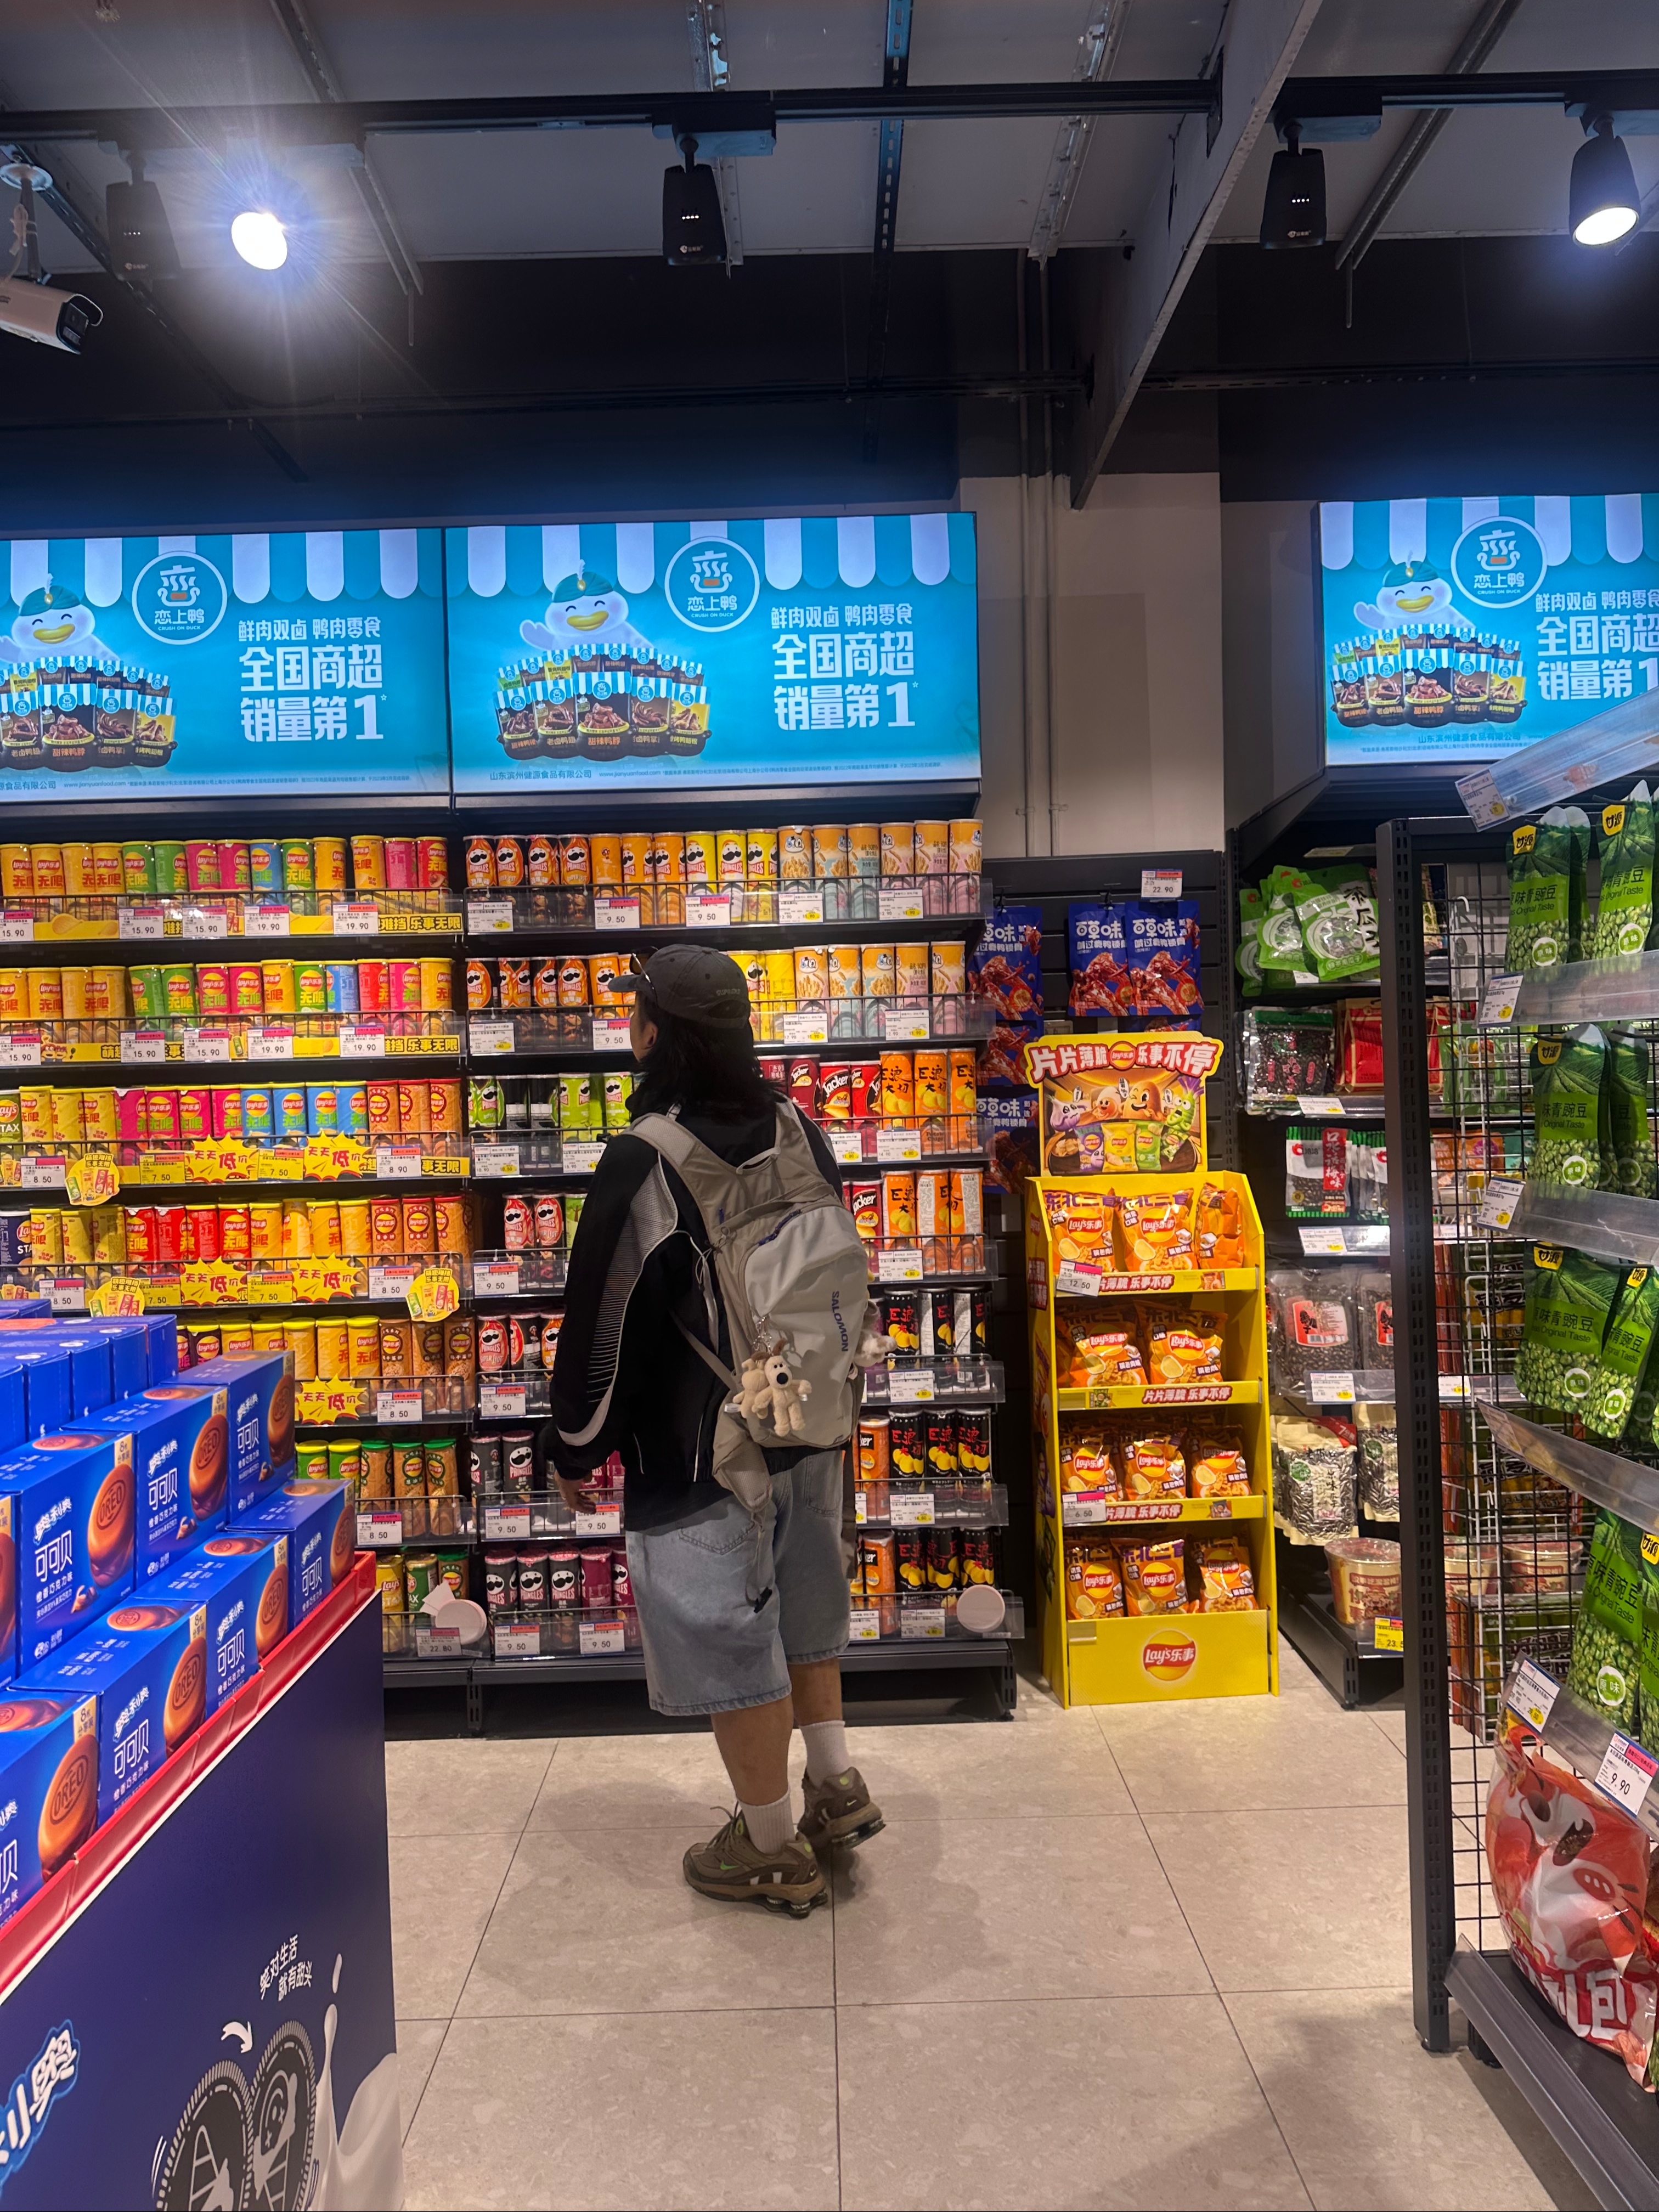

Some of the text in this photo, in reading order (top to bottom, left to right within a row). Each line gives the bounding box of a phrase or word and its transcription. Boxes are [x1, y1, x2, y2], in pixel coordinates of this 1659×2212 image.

[1474, 573, 1525, 589] 恋上鸭
[687, 595, 737, 611] 恋上鸭
[1536, 590, 1659, 612] 鲜肉双卤 鸭肉零食
[155, 609, 205, 624] 恋上鸭
[771, 603, 912, 629] 鲜肉双卤 鸭肉零食
[239, 616, 381, 642] 鲜肉双卤 鸭肉零食
[1537, 614, 1659, 656] 全国商超
[772, 631, 915, 680] 全国商超
[239, 644, 382, 692] 全国商超
[775, 684, 916, 730] 销量第1
[241, 694, 383, 742] 销量第1
[588, 737, 620, 746] 甜辣鸭脖
[53, 748, 85, 757] 甜辣鸭脖
[490, 770, 592, 781] 山东滨州健源食品有限公司
[1605, 812, 1622, 828] 甘源
[1516, 834, 1534, 850] 甘源
[470, 862, 489, 873] PRINGLES
[567, 861, 586, 872] PRINGLES
[287, 870, 311, 881] 无限
[1622, 885, 1644, 896] Taste
[1538, 902, 1555, 911] Taste
[410, 917, 461, 930] 乐事无限
[1076, 920, 1122, 939] 百草味
[1132, 918, 1177, 937] 百草味
[562, 982, 582, 992] PRINGLES
[168, 997, 193, 1009] 无限
[202, 994, 227, 1006] 无限
[300, 992, 324, 1003] 无限
[407, 1037, 459, 1052] 乐事无限
[1541, 1045, 1559, 1059] 甘源
[1031, 1042, 1216, 1080] 片片薄脆 乐事不停
[791, 1068, 809, 1082] Jacker
[822, 1075, 849, 1097] Jacker
[245, 1115, 270, 1127] 无限
[1566, 1119, 1585, 1129] Taste
[1069, 1220, 1103, 1231] Lay's乐事
[1538, 1251, 1561, 1264] 甘源
[1130, 1276, 1173, 1289] 乐事不停
[831, 1290, 849, 1352] SALOMON
[1568, 1332, 1591, 1344] Taste
[356, 1351, 379, 1364] 无限
[1144, 1386, 1231, 1403] 片片薄脆 乐事不停
[237, 1418, 259, 1454] 可可贝
[510, 1464, 533, 1478] PRINGLES
[148, 1468, 178, 1510] 可可贝
[99, 1484, 123, 1522] OREO
[1139, 1504, 1181, 1519] 乐事不停
[35, 1498, 72, 1542] 奥利奥
[35, 1530, 72, 1583] 可可贝
[301, 1556, 323, 1596] 可可贝
[382, 1579, 400, 1591] Lay's
[520, 1588, 544, 1601] PRINGLES
[552, 1588, 575, 1600] PRINGLES
[1614, 1606, 1635, 1624] Taste
[217, 1628, 245, 1677] 可可贝
[174, 1662, 199, 1704] OREO
[1599, 1678, 1620, 1694] 原味
[115, 1686, 150, 1740] 奥利奥
[114, 1718, 150, 1780] 可可贝
[52, 1758, 87, 1819] OREO
[278, 1960, 312, 2002] 就有甜头
